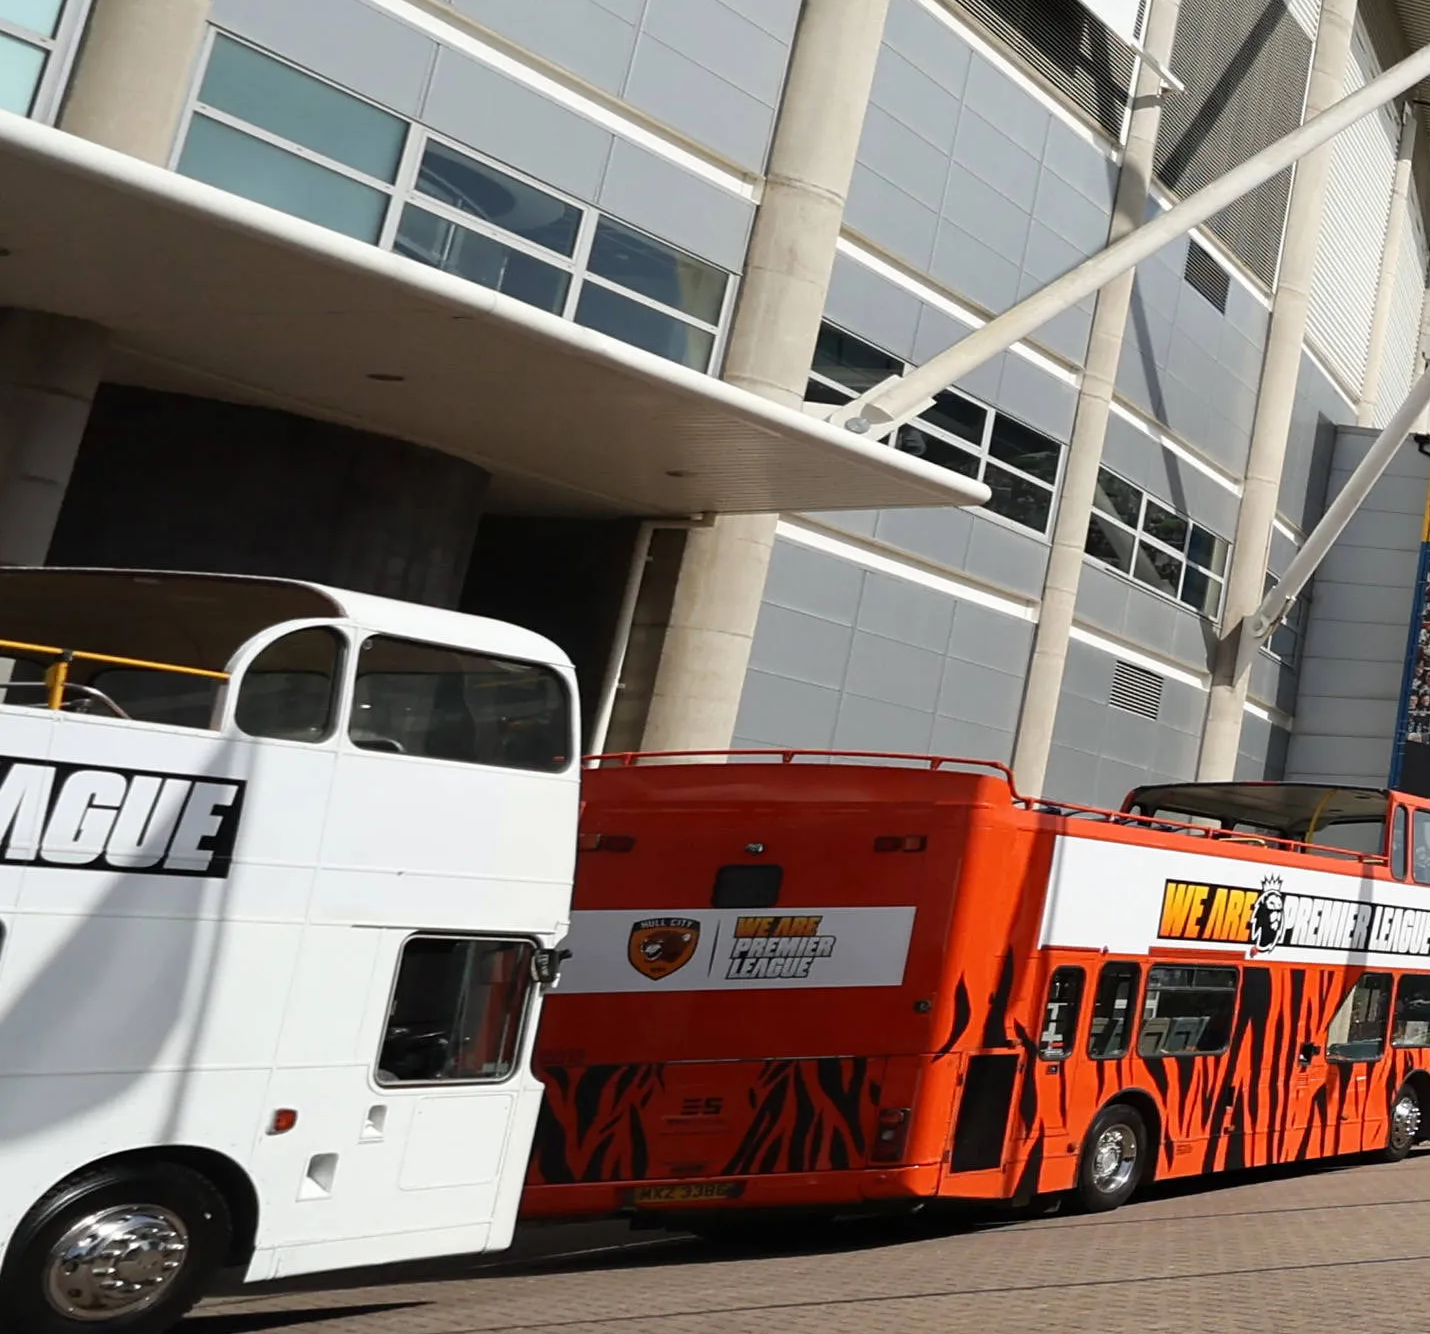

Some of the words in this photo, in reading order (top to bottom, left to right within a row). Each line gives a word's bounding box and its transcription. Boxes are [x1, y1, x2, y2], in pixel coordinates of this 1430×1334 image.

[641, 919, 666, 927] HULL
[671, 919, 693, 927] CITY
[1159, 882, 1210, 938] WE
[1202, 888, 1259, 941] ARE
[1278, 895, 1372, 950] PREMIER
[736, 917, 773, 936] WE
[775, 917, 820, 936] ARE
[732, 937, 835, 957] PREMIER
[728, 958, 813, 978] LEAGUE
